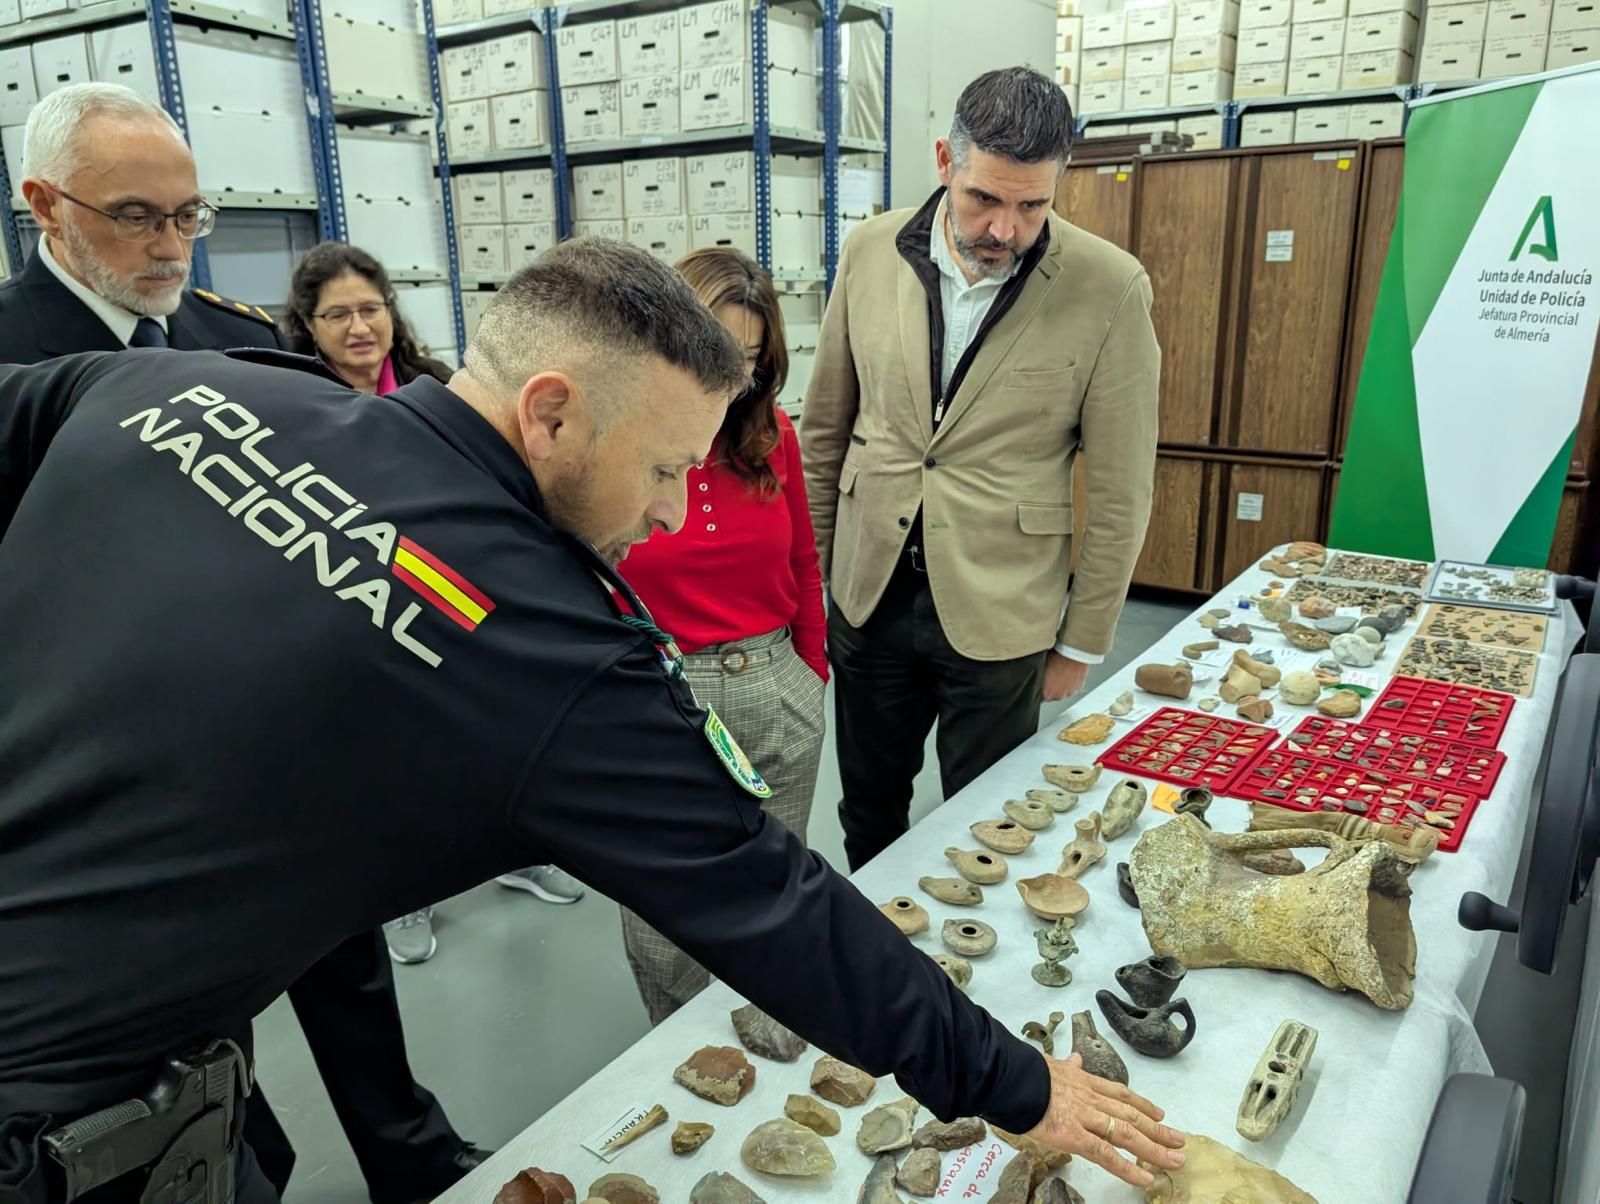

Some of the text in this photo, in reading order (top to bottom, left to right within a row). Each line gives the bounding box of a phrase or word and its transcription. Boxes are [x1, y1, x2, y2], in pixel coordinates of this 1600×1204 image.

[682, 10, 698, 28] LM
[560, 30, 576, 47] LM
[622, 22, 638, 38] LM
[683, 73, 701, 90] LM
[624, 84, 640, 98] LM
[626, 165, 640, 178] LM
[690, 160, 705, 175] LM
[631, 223, 645, 235] LM
[695, 217, 710, 232] LM
[1478, 268, 1592, 285] Junta de Andalucía
[1479, 289, 1586, 307] Unidad de Policía
[1479, 307, 1579, 326] Jefatura Provincial
[1494, 326, 1550, 343] de Almería
[119, 407, 443, 669] NACIONAL
[937, 1141, 984, 1197] ascaux
[962, 1143, 1003, 1199] Cerca de
